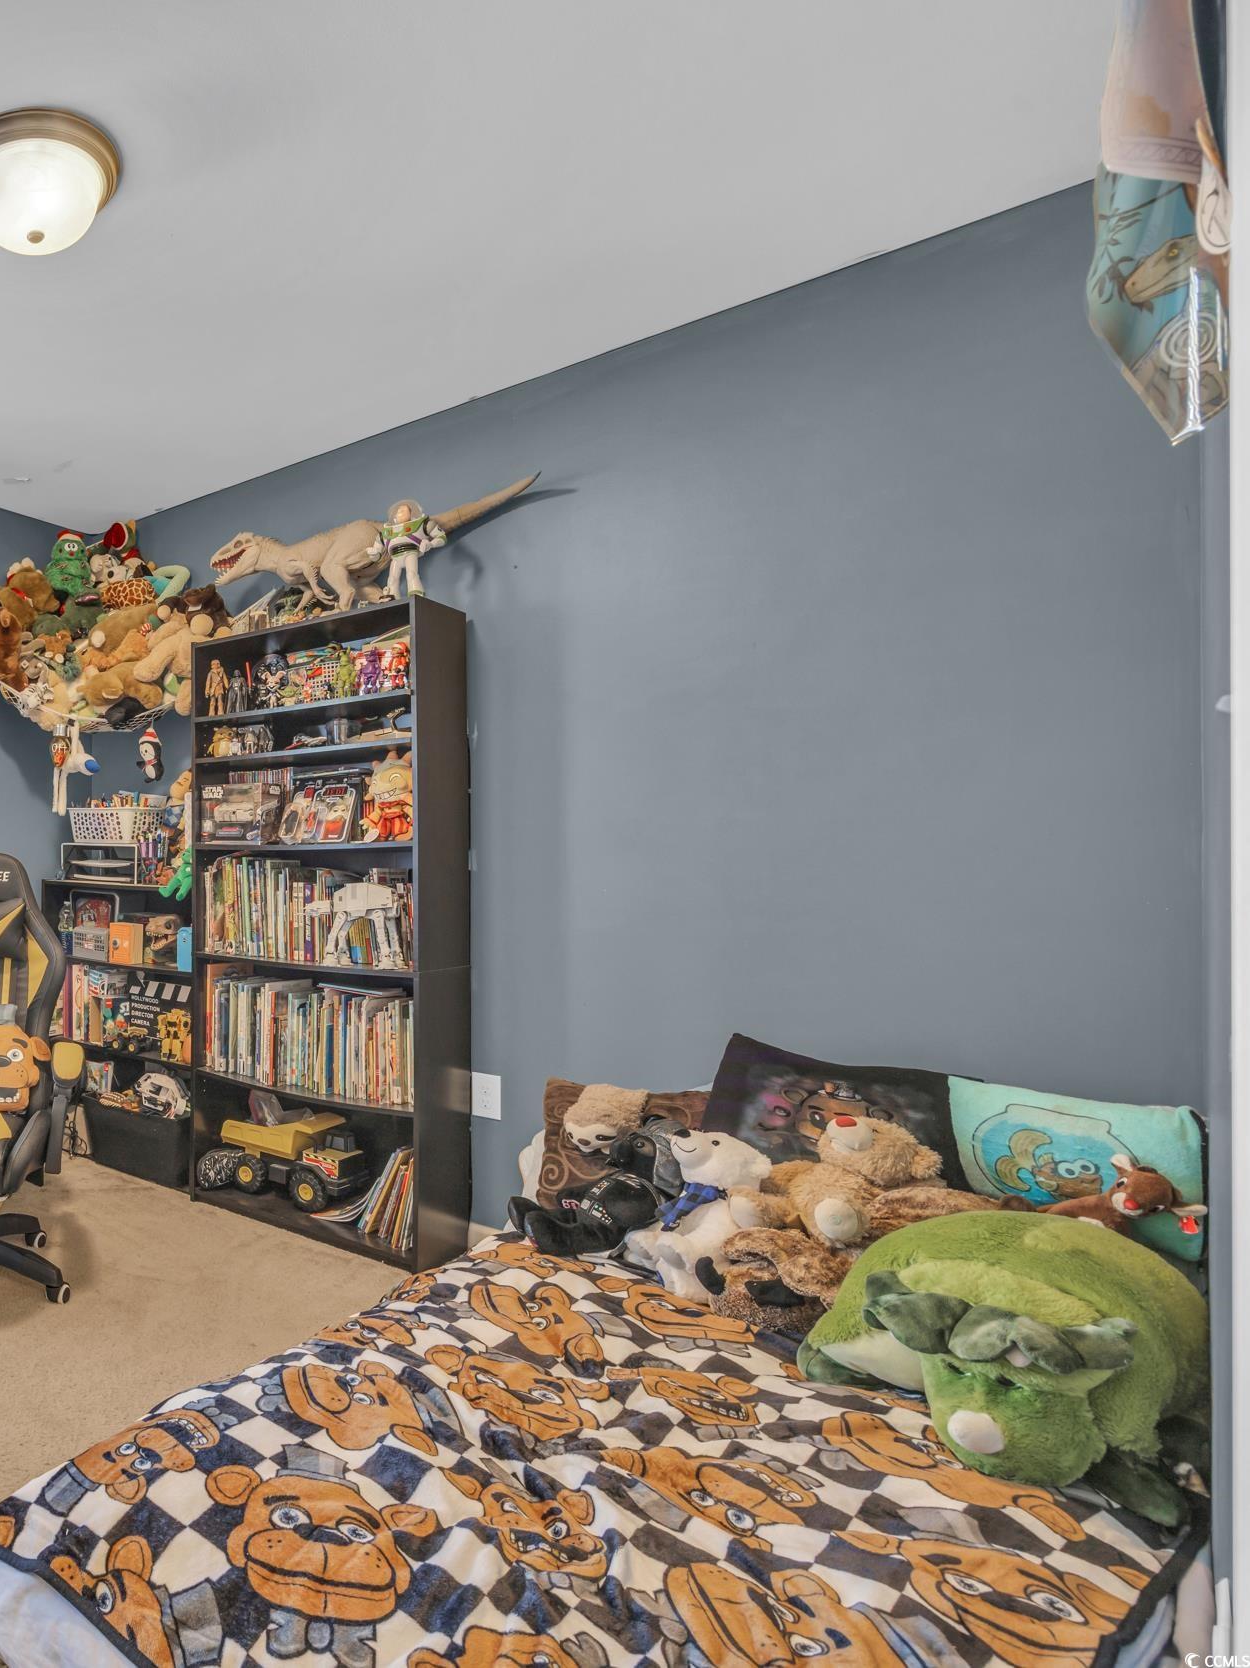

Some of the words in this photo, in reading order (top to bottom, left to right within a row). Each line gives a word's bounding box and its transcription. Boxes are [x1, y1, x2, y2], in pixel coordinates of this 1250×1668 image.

[202, 791, 223, 799] WARS
[131, 994, 159, 1004] HOLLYWOOD
[131, 1003, 160, 1012] PRODUCTION
[131, 1011, 154, 1019] DIRECTOR
[130, 1018, 150, 1027] CAMERA
